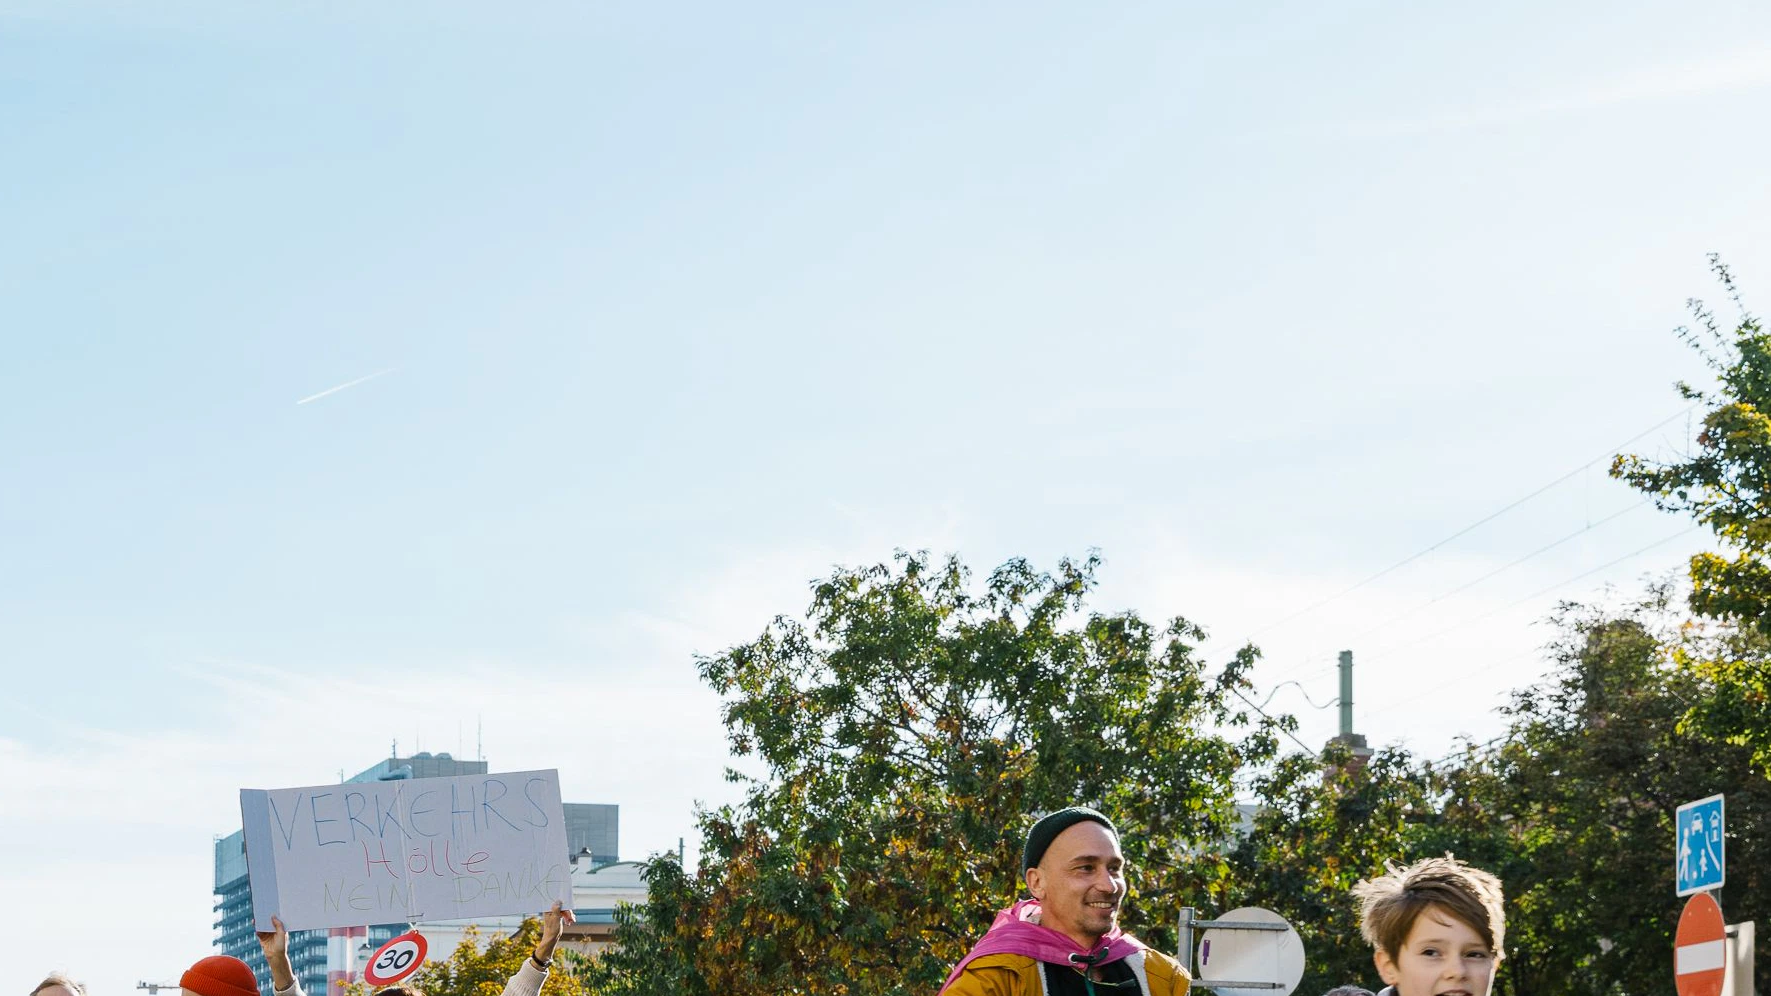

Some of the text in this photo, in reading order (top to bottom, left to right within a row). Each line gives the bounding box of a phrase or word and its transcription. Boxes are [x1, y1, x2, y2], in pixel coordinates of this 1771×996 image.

[269, 778, 549, 850] VERKEHRS
[324, 863, 565, 912] NEIN DANKE
[376, 949, 414, 970] 30
